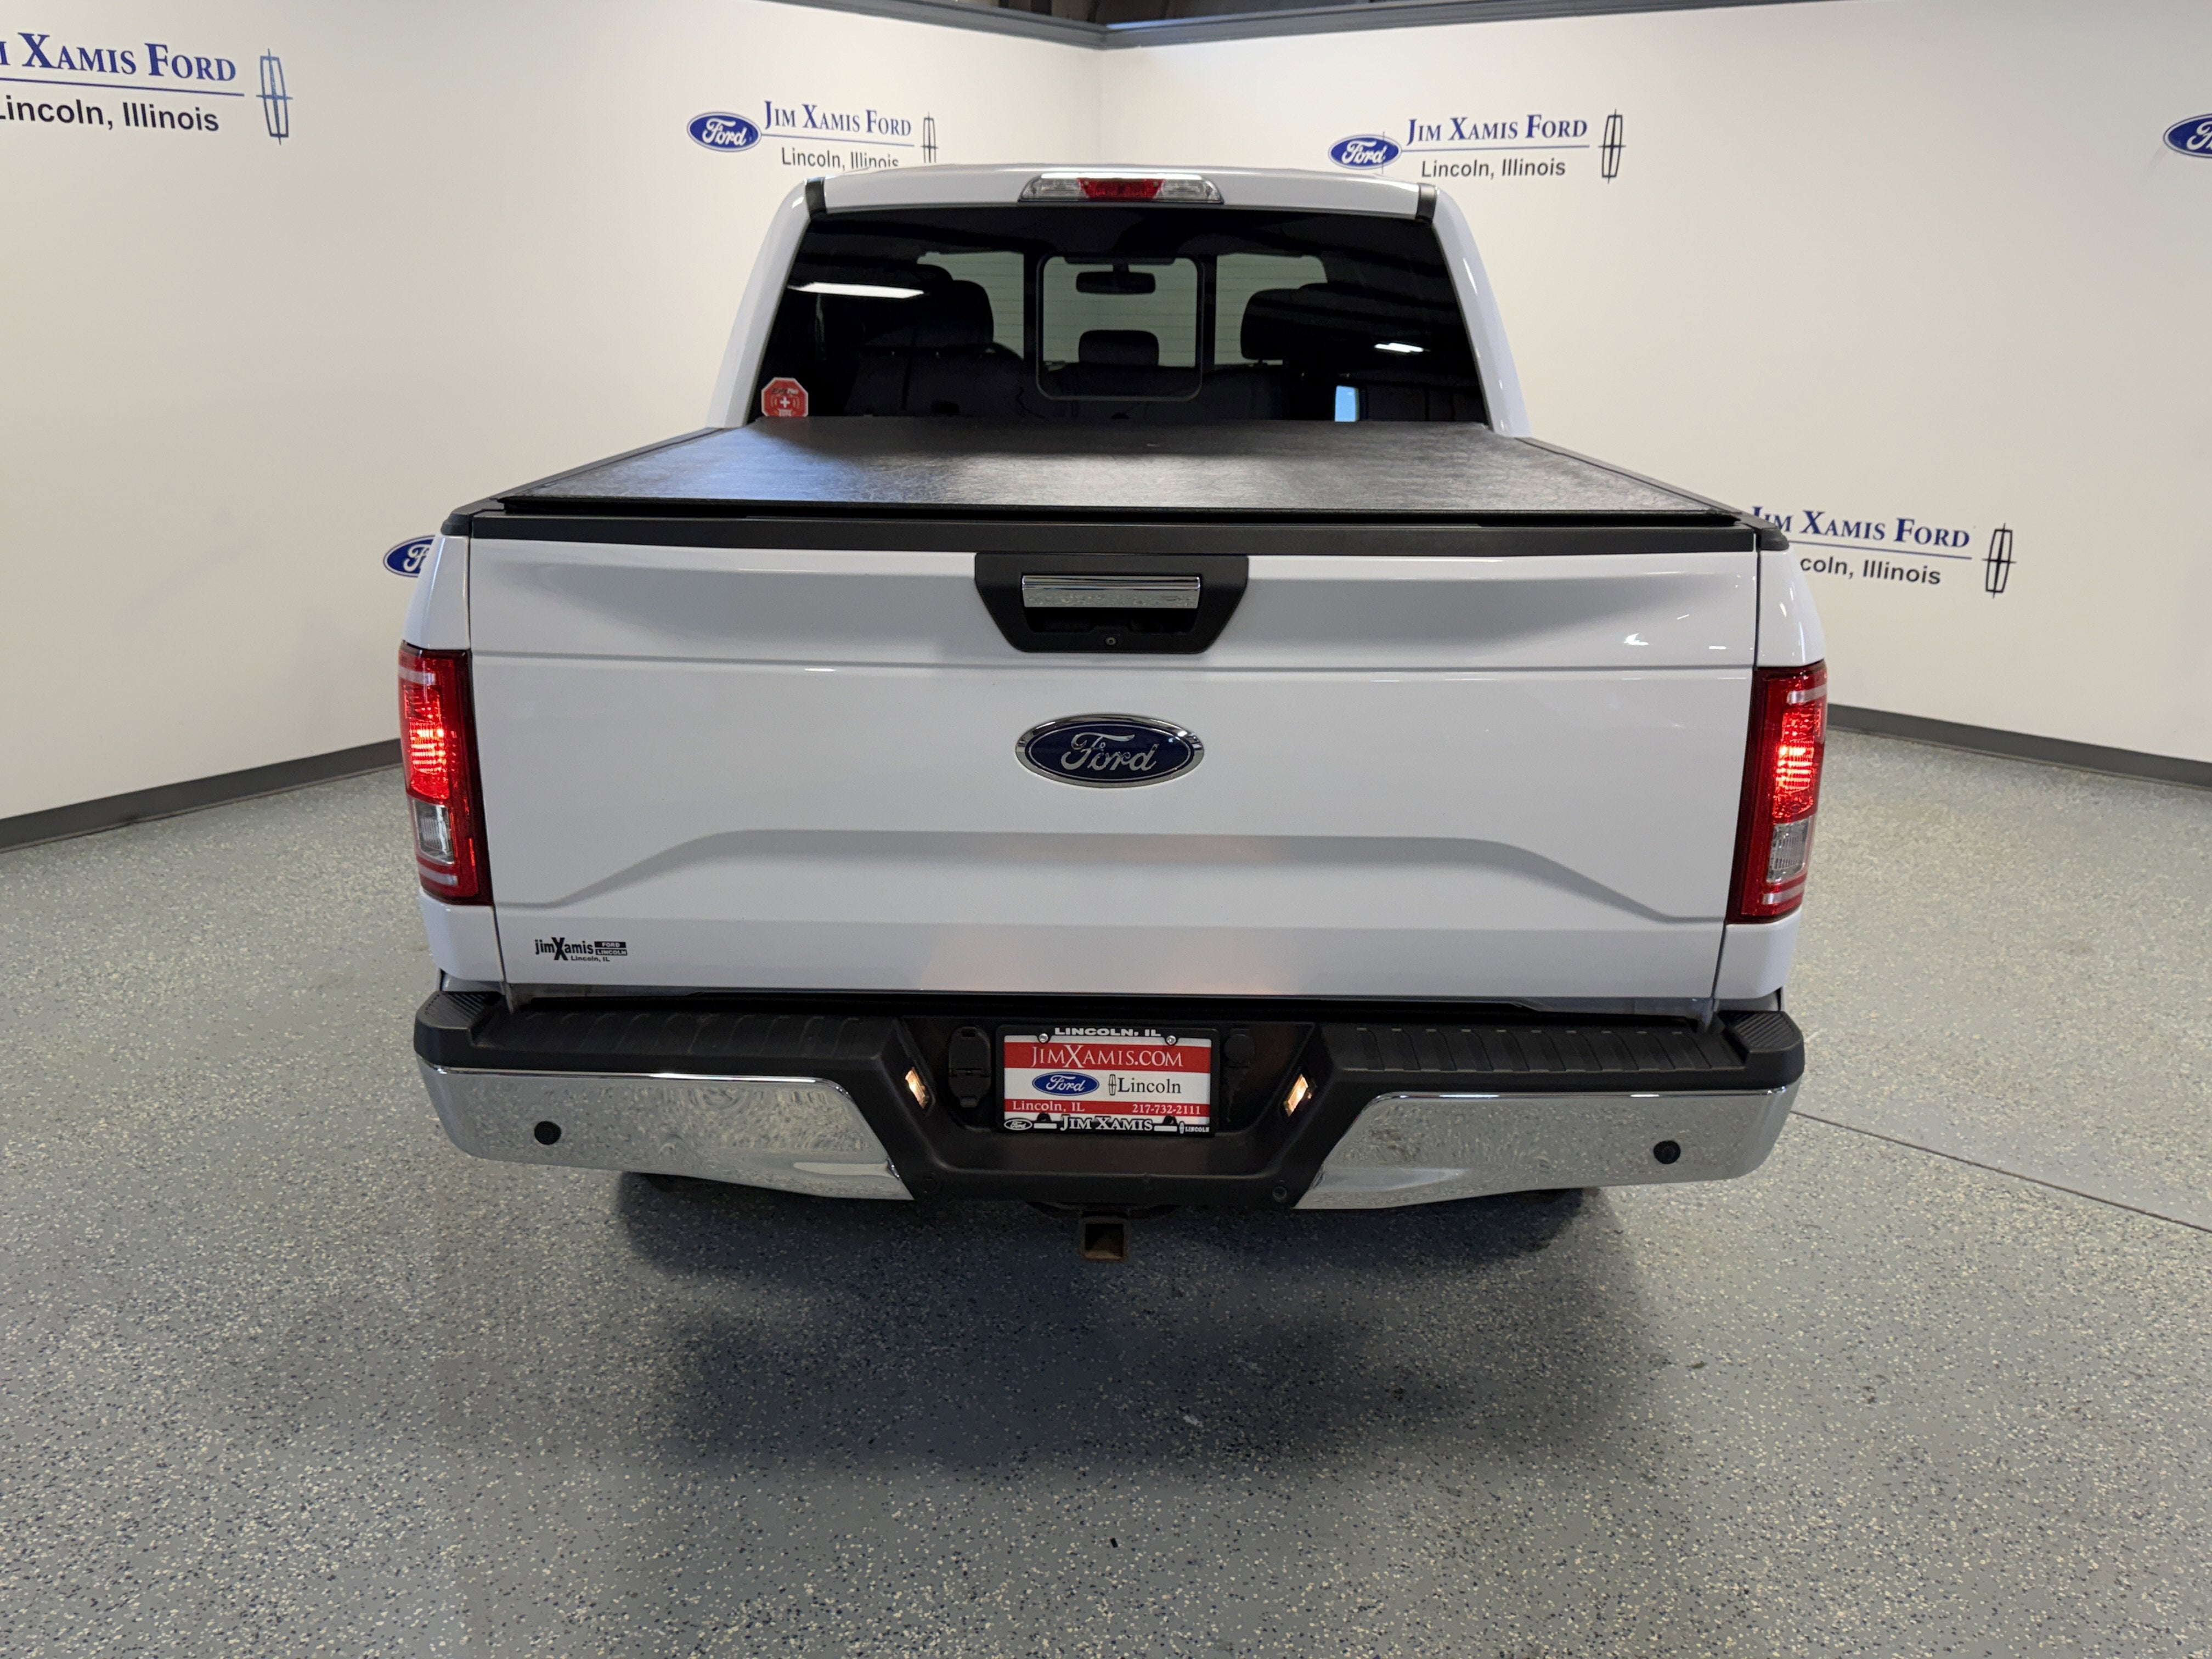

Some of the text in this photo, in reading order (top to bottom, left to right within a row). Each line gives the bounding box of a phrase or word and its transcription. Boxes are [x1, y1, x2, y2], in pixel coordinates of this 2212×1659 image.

[18, 32, 137, 75] XAMIS
[144, 43, 236, 81] FORD
[0, 94, 219, 131] incoln, Illinois
[764, 100, 911, 136] JIM XAMIS FORD
[702, 117, 747, 146] Ford
[1407, 114, 1587, 146] JIM XAMIS FORD
[782, 147, 899, 171] Lincoln, Illinois
[1341, 140, 1386, 164] Ford
[1421, 158, 1566, 180] Lincoln, Illinois
[1799, 510, 1886, 540] XAMIS
[1893, 517, 1970, 548] FORD
[1800, 556, 1941, 585] coln, Illinois
[1060, 731, 1158, 771] Ford
[1046, 1074, 1086, 1092] Ford
[1118, 1077, 1182, 1094] Lincoln
[1013, 1101, 1085, 1113] Lincoln, IL
[1132, 1104, 1200, 1114] 217-732-2111
[1009, 1121, 1026, 1129] Ford
[1060, 1115, 1153, 1131] JIM XAMIS
